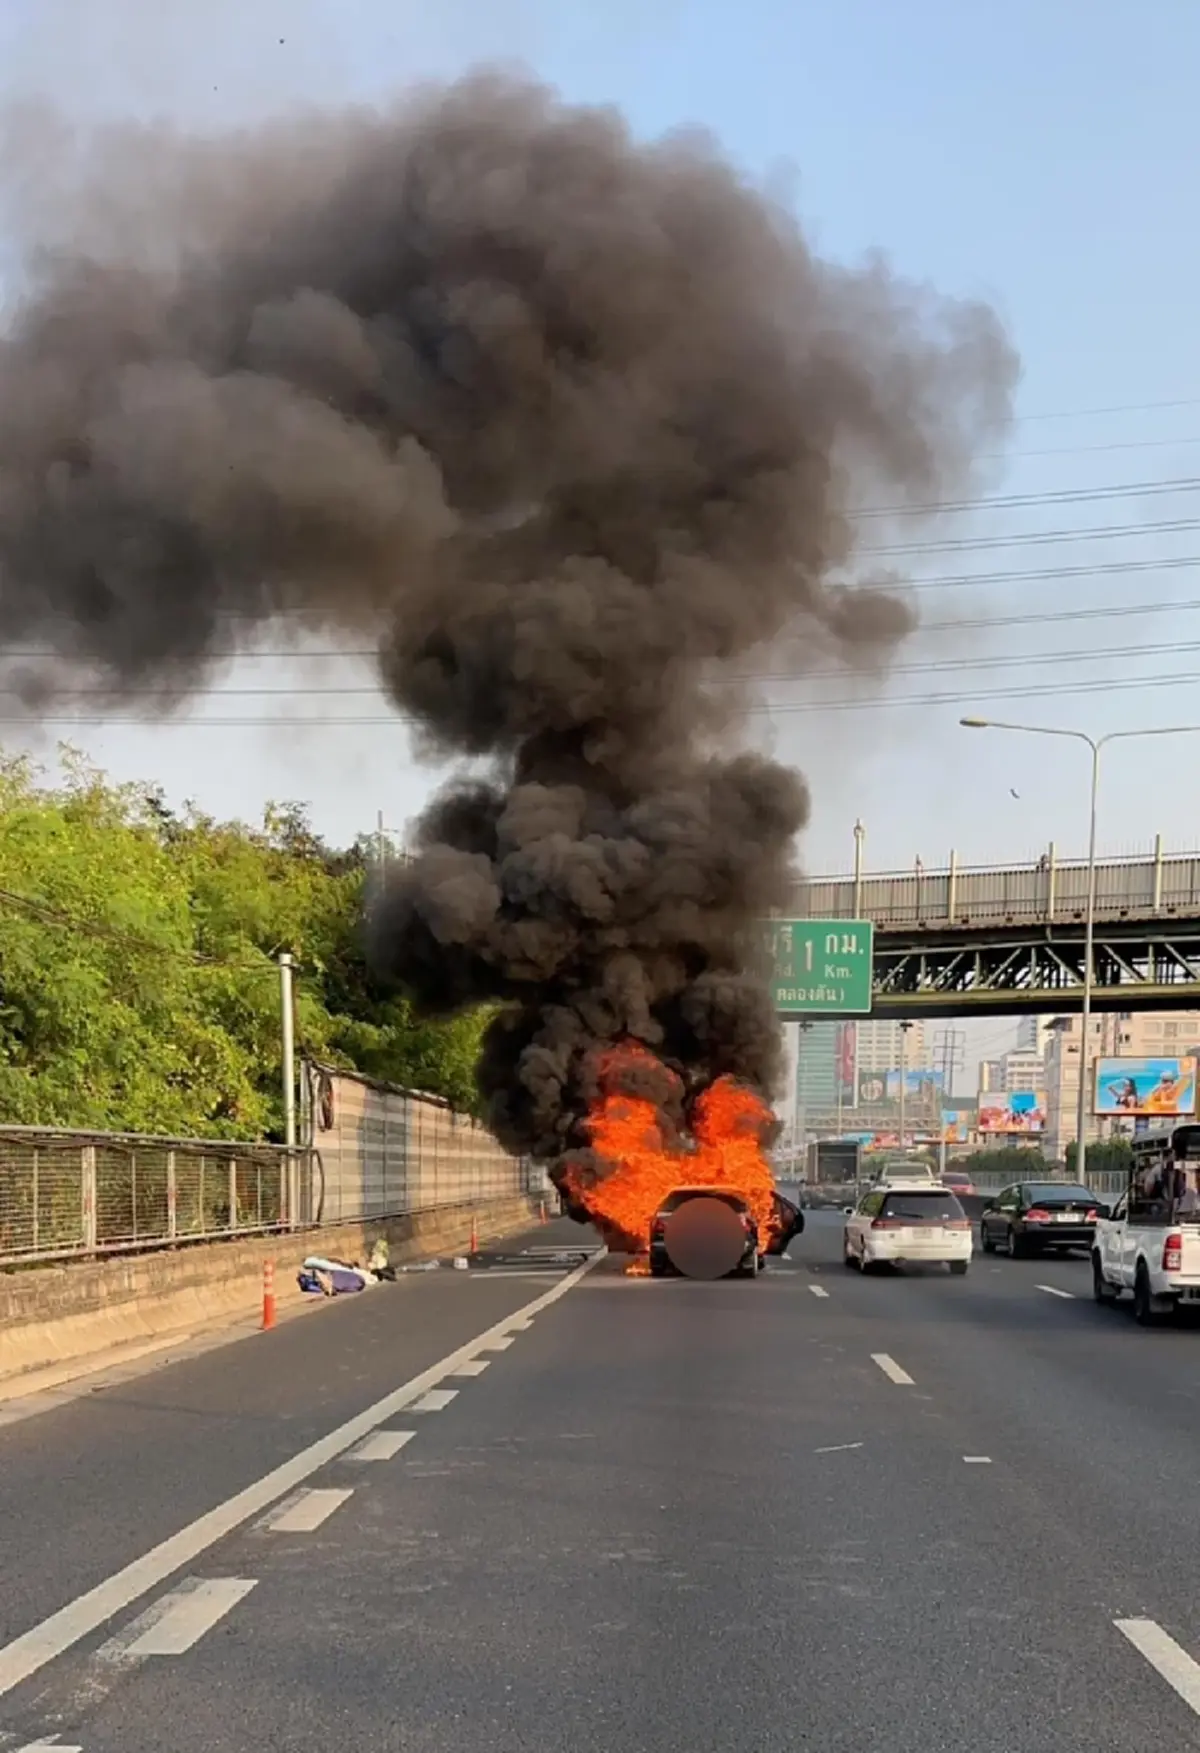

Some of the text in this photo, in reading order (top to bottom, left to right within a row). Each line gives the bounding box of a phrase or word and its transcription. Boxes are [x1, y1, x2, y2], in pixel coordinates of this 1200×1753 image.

[825, 933, 865, 955] กม.
[804, 940, 813, 973] 1
[824, 963, 853, 979] Km.
